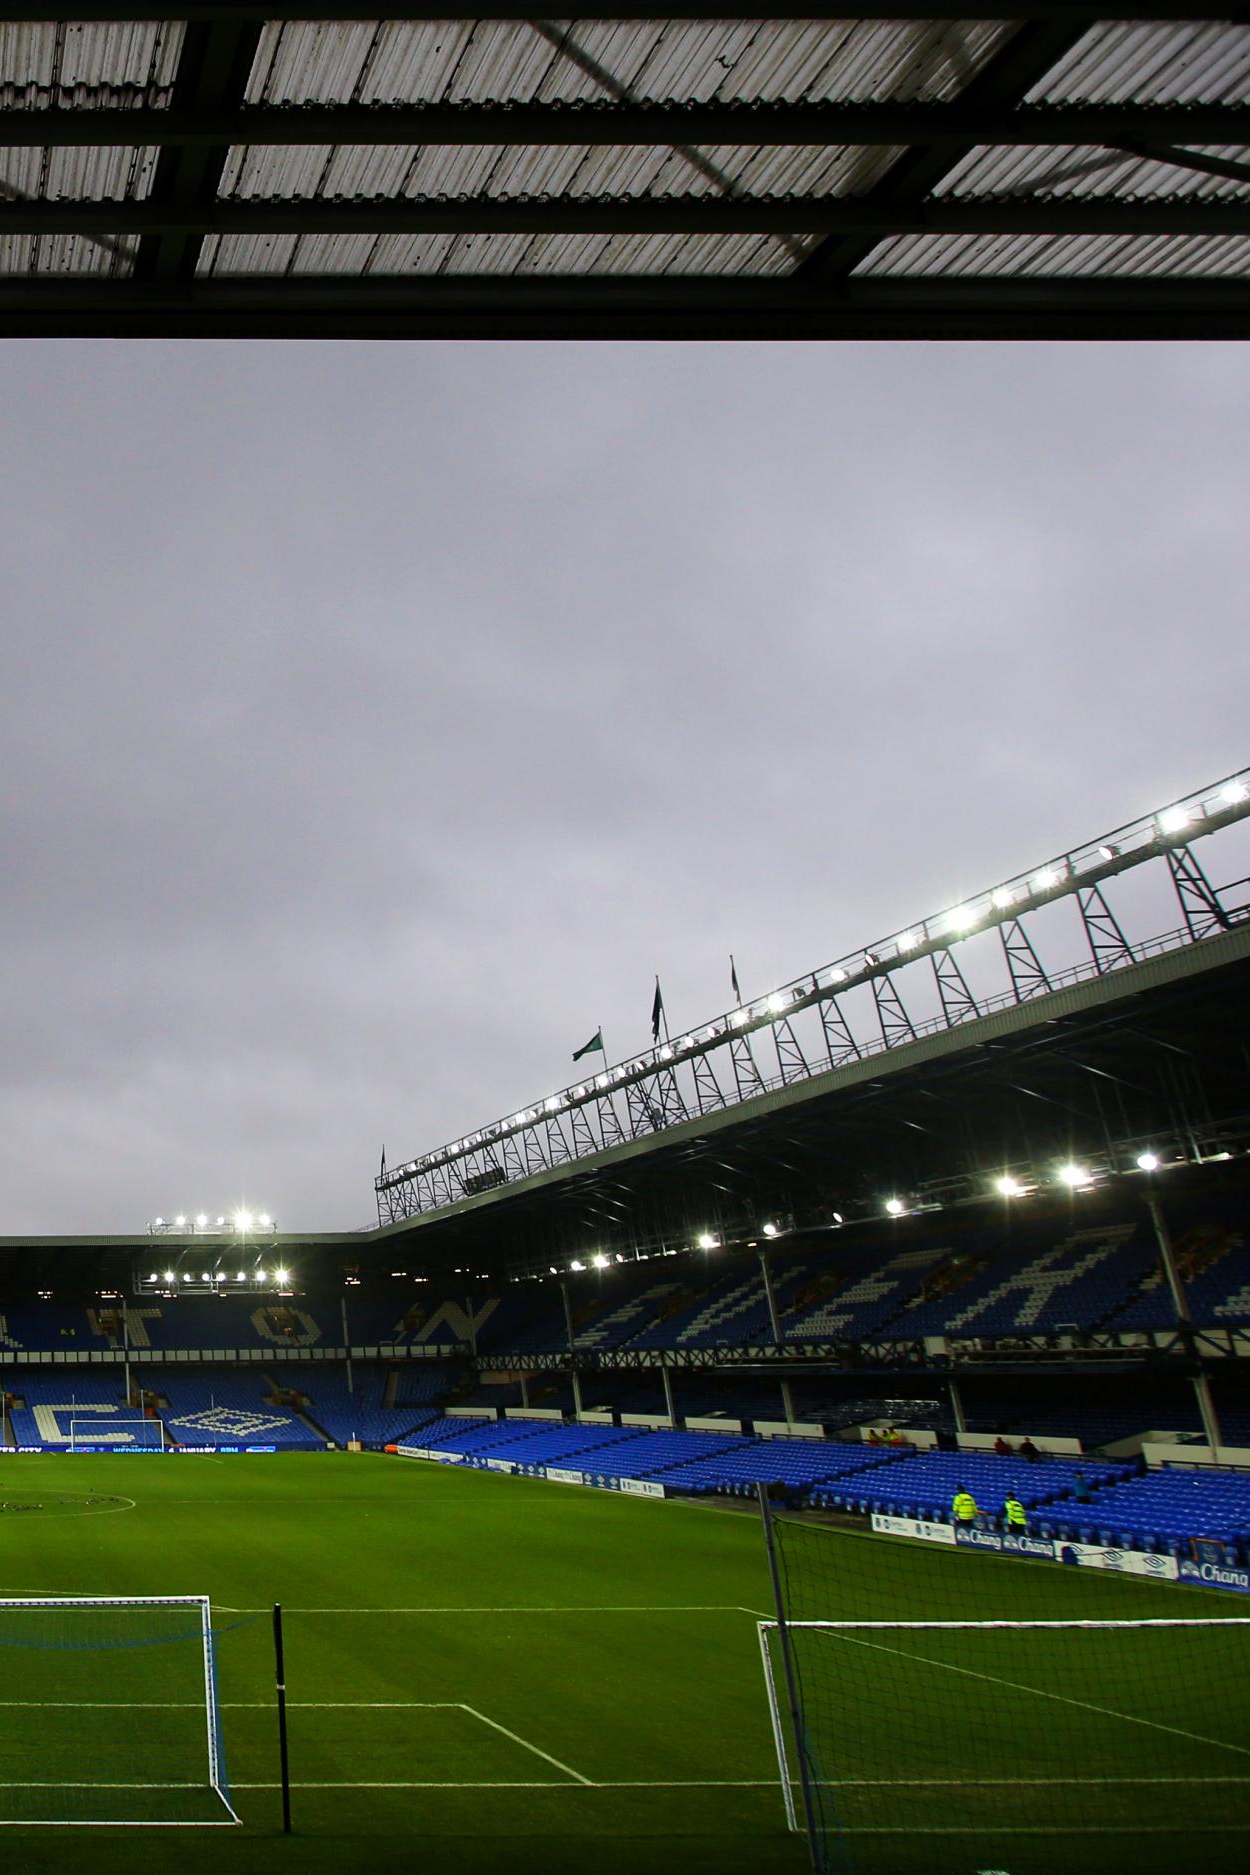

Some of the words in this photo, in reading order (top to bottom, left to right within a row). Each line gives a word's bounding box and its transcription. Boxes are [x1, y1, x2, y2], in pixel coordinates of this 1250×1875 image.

[970, 1529, 1002, 1550] Chang
[1018, 1536, 1054, 1557] Chang
[1200, 1563, 1249, 1588] Chang
